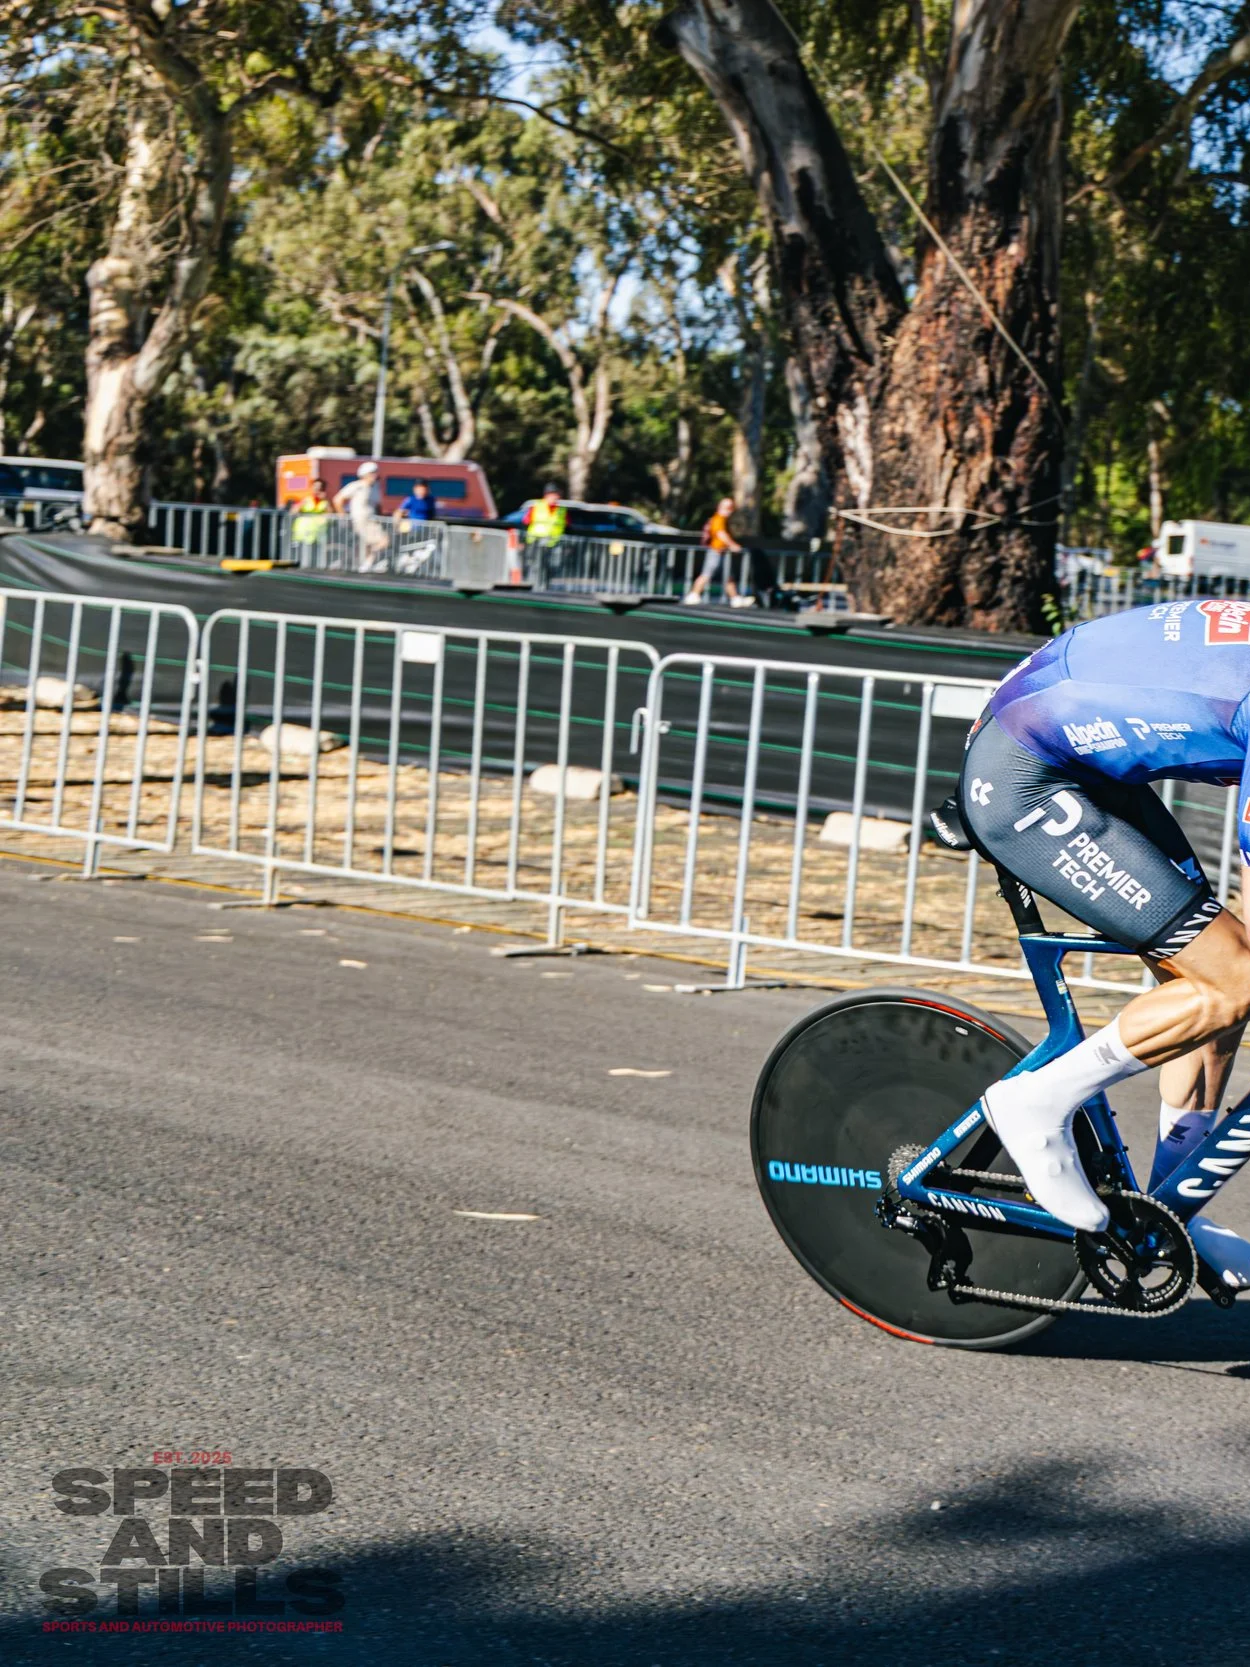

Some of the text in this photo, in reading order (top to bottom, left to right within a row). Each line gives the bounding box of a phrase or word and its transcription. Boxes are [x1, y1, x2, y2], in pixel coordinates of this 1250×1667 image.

[1062, 716, 1121, 747] Alpecin
[1149, 722, 1194, 732] PREMIER
[1156, 732, 1186, 740] TECH
[1051, 849, 1105, 901] TECH
[1067, 832, 1152, 911] PREMIER
[1147, 896, 1223, 959] CANYO
[768, 1160, 882, 1190] SHIMANO
[902, 1146, 942, 1186] SHIMANO
[927, 1191, 1007, 1222] CANYON
